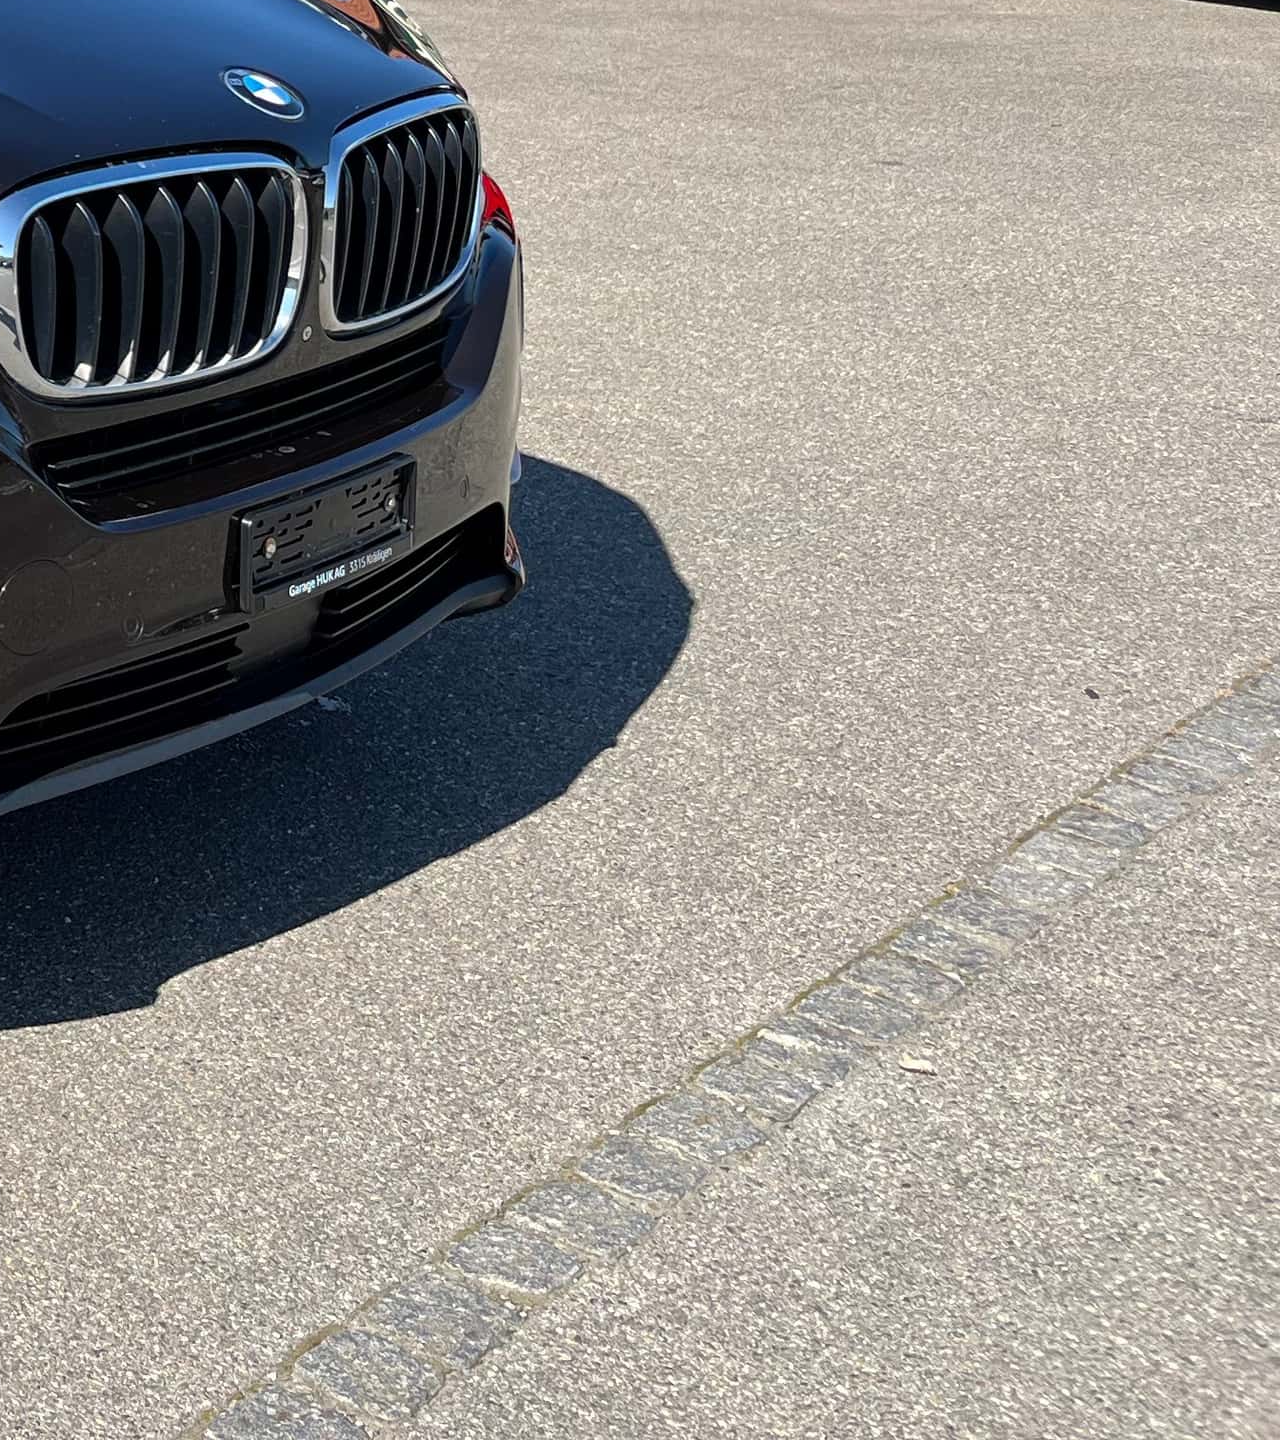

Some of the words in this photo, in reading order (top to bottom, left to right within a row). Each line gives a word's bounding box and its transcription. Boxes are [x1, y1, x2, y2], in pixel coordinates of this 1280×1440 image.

[288, 578, 316, 597] Garage
[316, 567, 334, 587] HUK
[334, 564, 346, 578] AG
